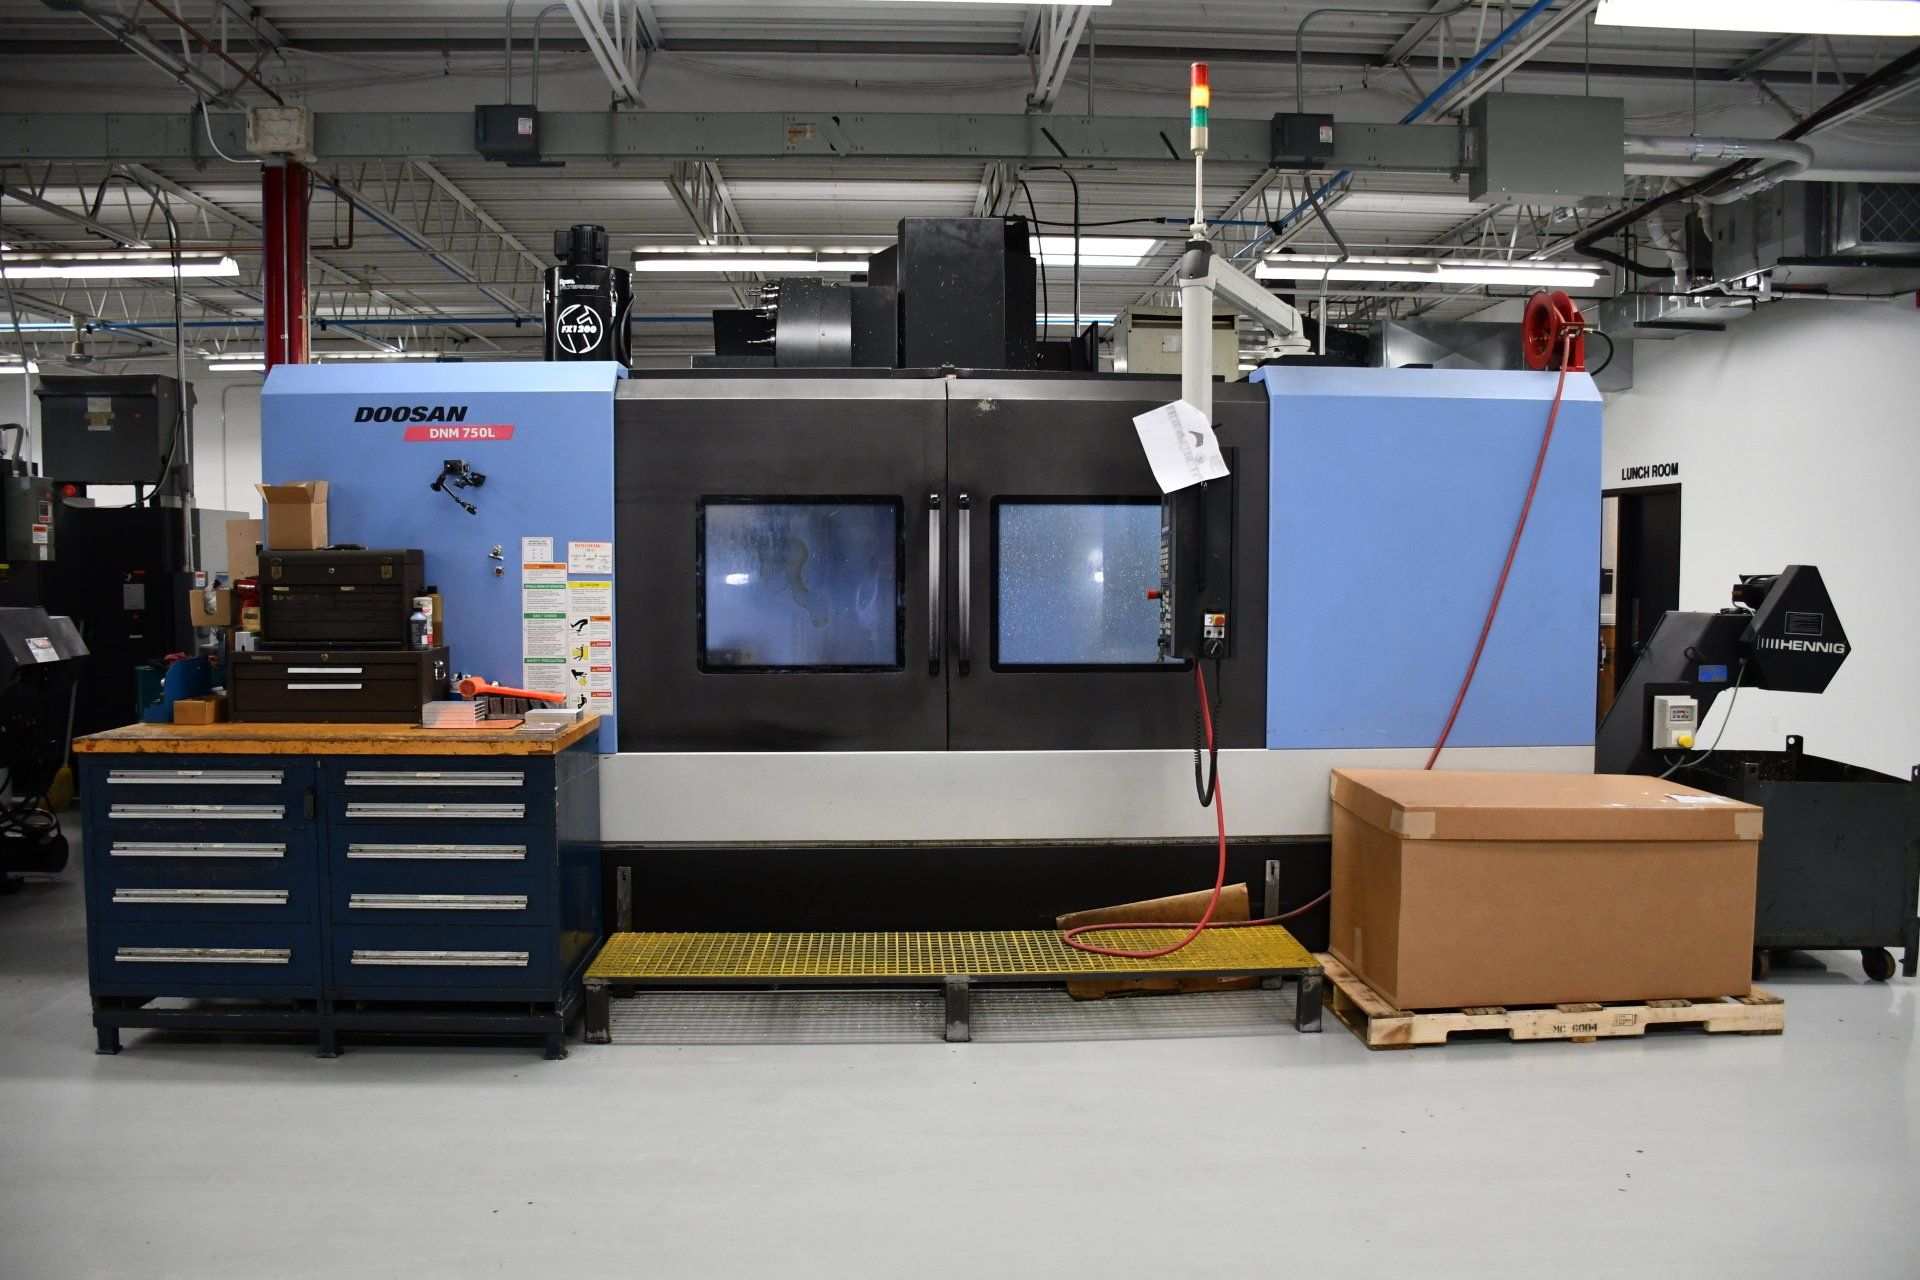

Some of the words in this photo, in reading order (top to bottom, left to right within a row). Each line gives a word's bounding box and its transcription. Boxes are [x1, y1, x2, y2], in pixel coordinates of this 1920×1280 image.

[561, 325, 597, 333] FX1200
[354, 406, 468, 423] DOOSAN
[429, 428, 459, 438] DNM
[463, 427, 495, 438] 750L
[1621, 465, 1650, 481] LUNCH
[1652, 462, 1679, 478] ROOM
[1780, 639, 1845, 654] HENNIG
[1572, 1022, 1598, 1033] 6004
